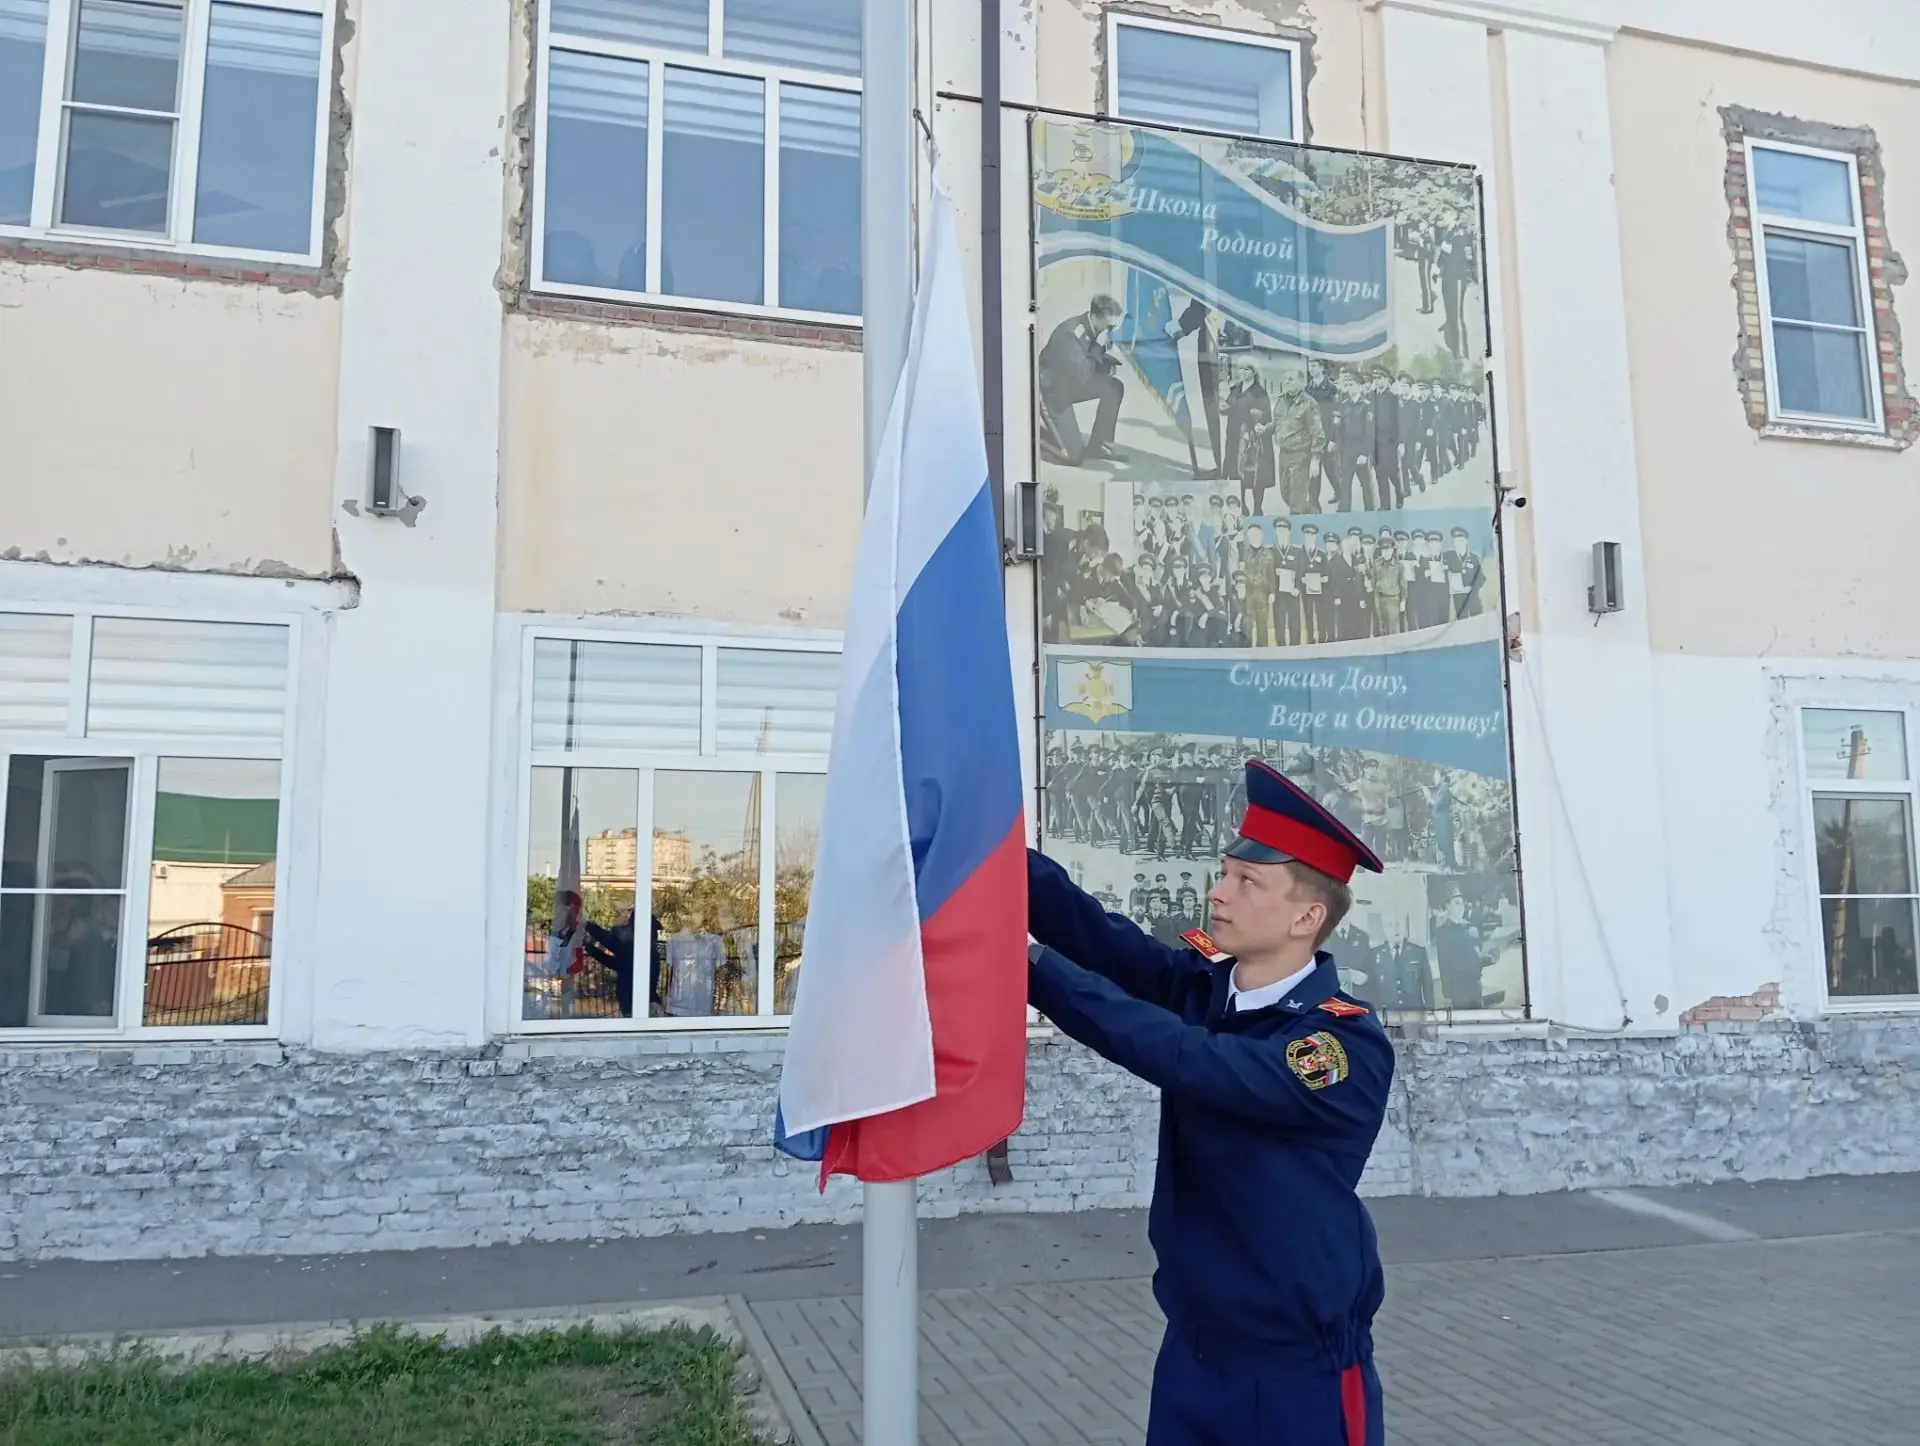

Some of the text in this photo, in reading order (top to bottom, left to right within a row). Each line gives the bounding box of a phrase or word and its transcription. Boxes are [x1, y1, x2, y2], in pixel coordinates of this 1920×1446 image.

[1128, 188, 1217, 220] Школа
[1200, 227, 1294, 260] Родной
[1254, 270, 1381, 302] культуры
[1228, 663, 1408, 696] Служим Дону,
[1268, 704, 1501, 738] Вере и Отечеству!
